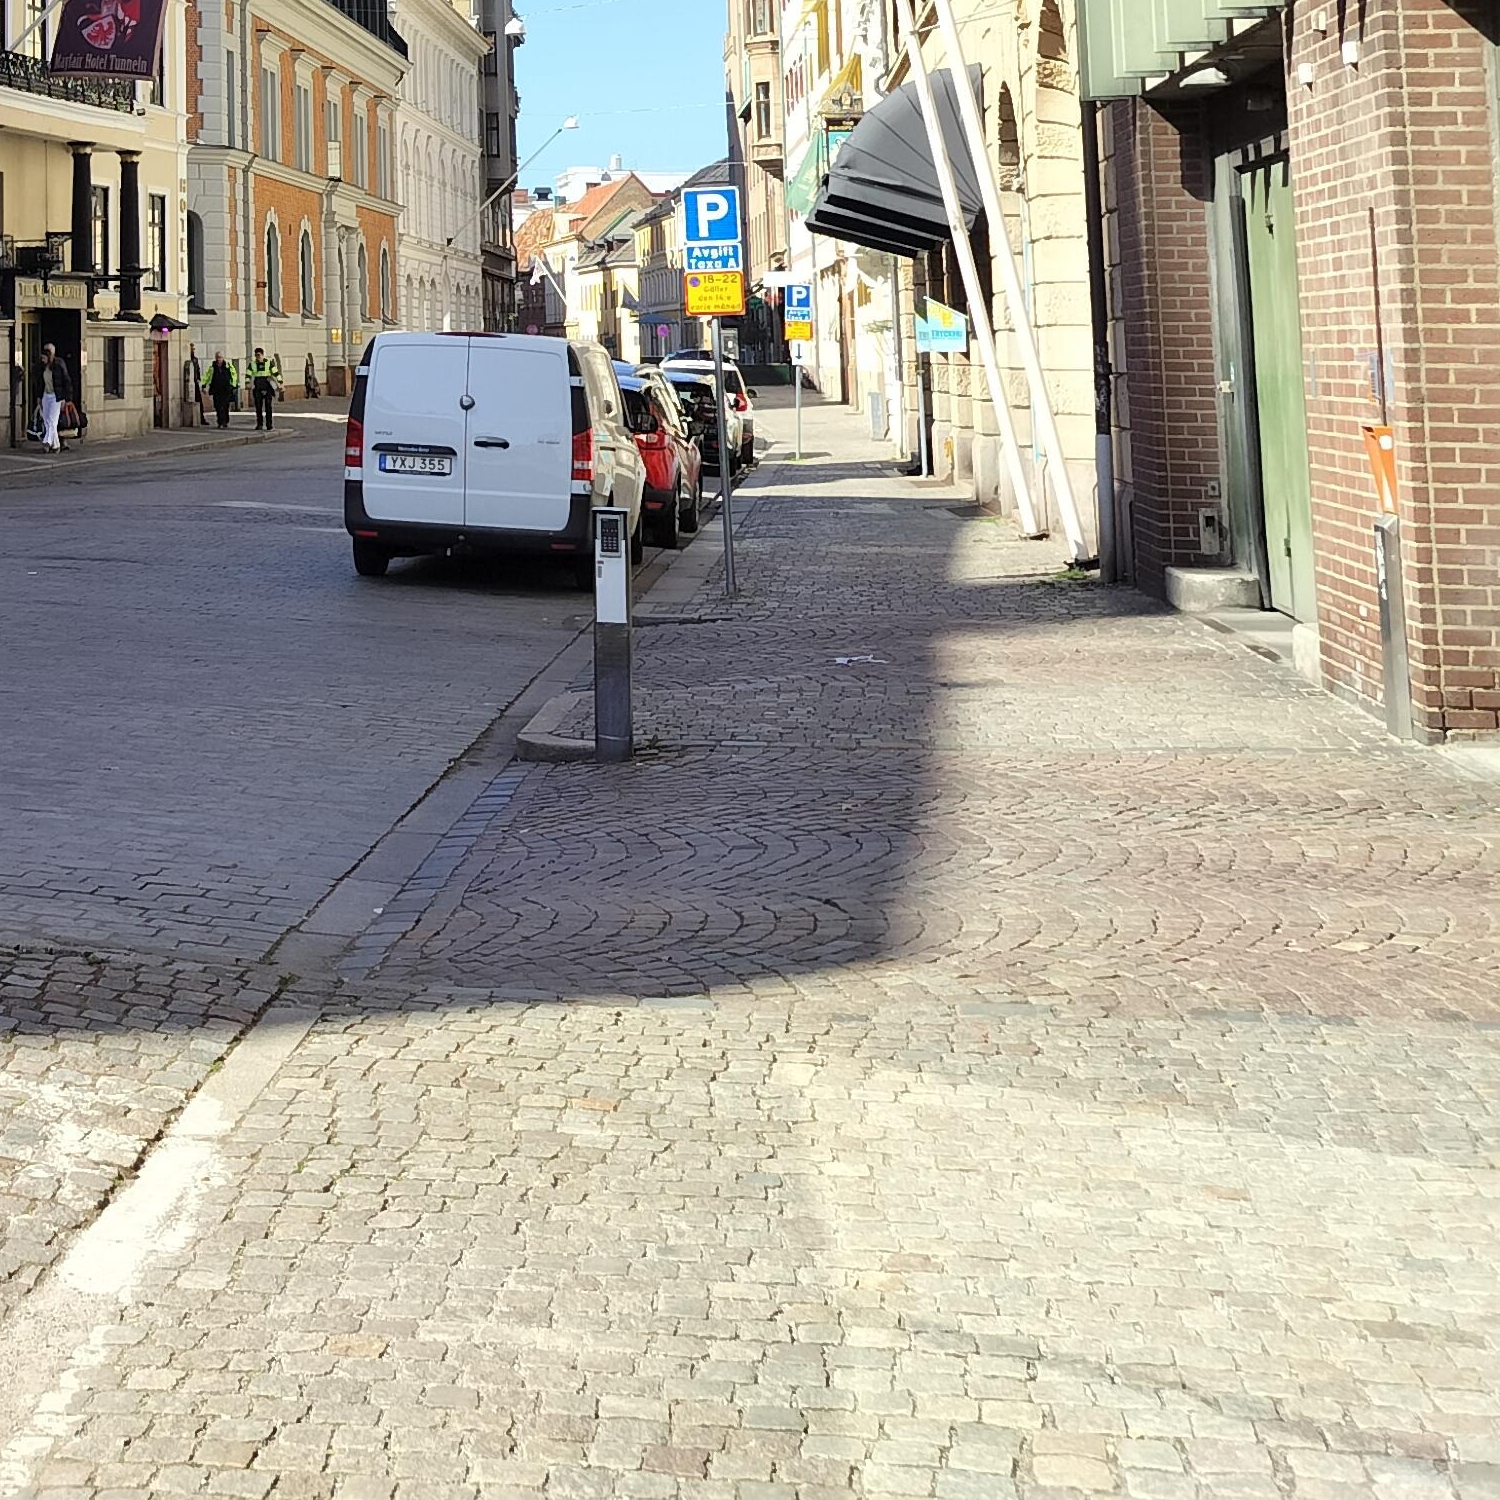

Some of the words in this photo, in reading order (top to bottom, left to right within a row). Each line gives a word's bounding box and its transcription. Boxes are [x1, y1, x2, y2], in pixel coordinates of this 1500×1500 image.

[53, 52, 85, 70] Mayfair
[84, 52, 108, 70] Hotel
[109, 54, 148, 73] Tunneln
[696, 193, 729, 238] P
[691, 245, 734, 259] Avgift
[689, 257, 723, 270] Taxa
[727, 257, 737, 269] A
[702, 274, 738, 284] 18-22
[792, 286, 807, 307] P
[390, 456, 417, 469] YXJ
[419, 457, 445, 471] 355
